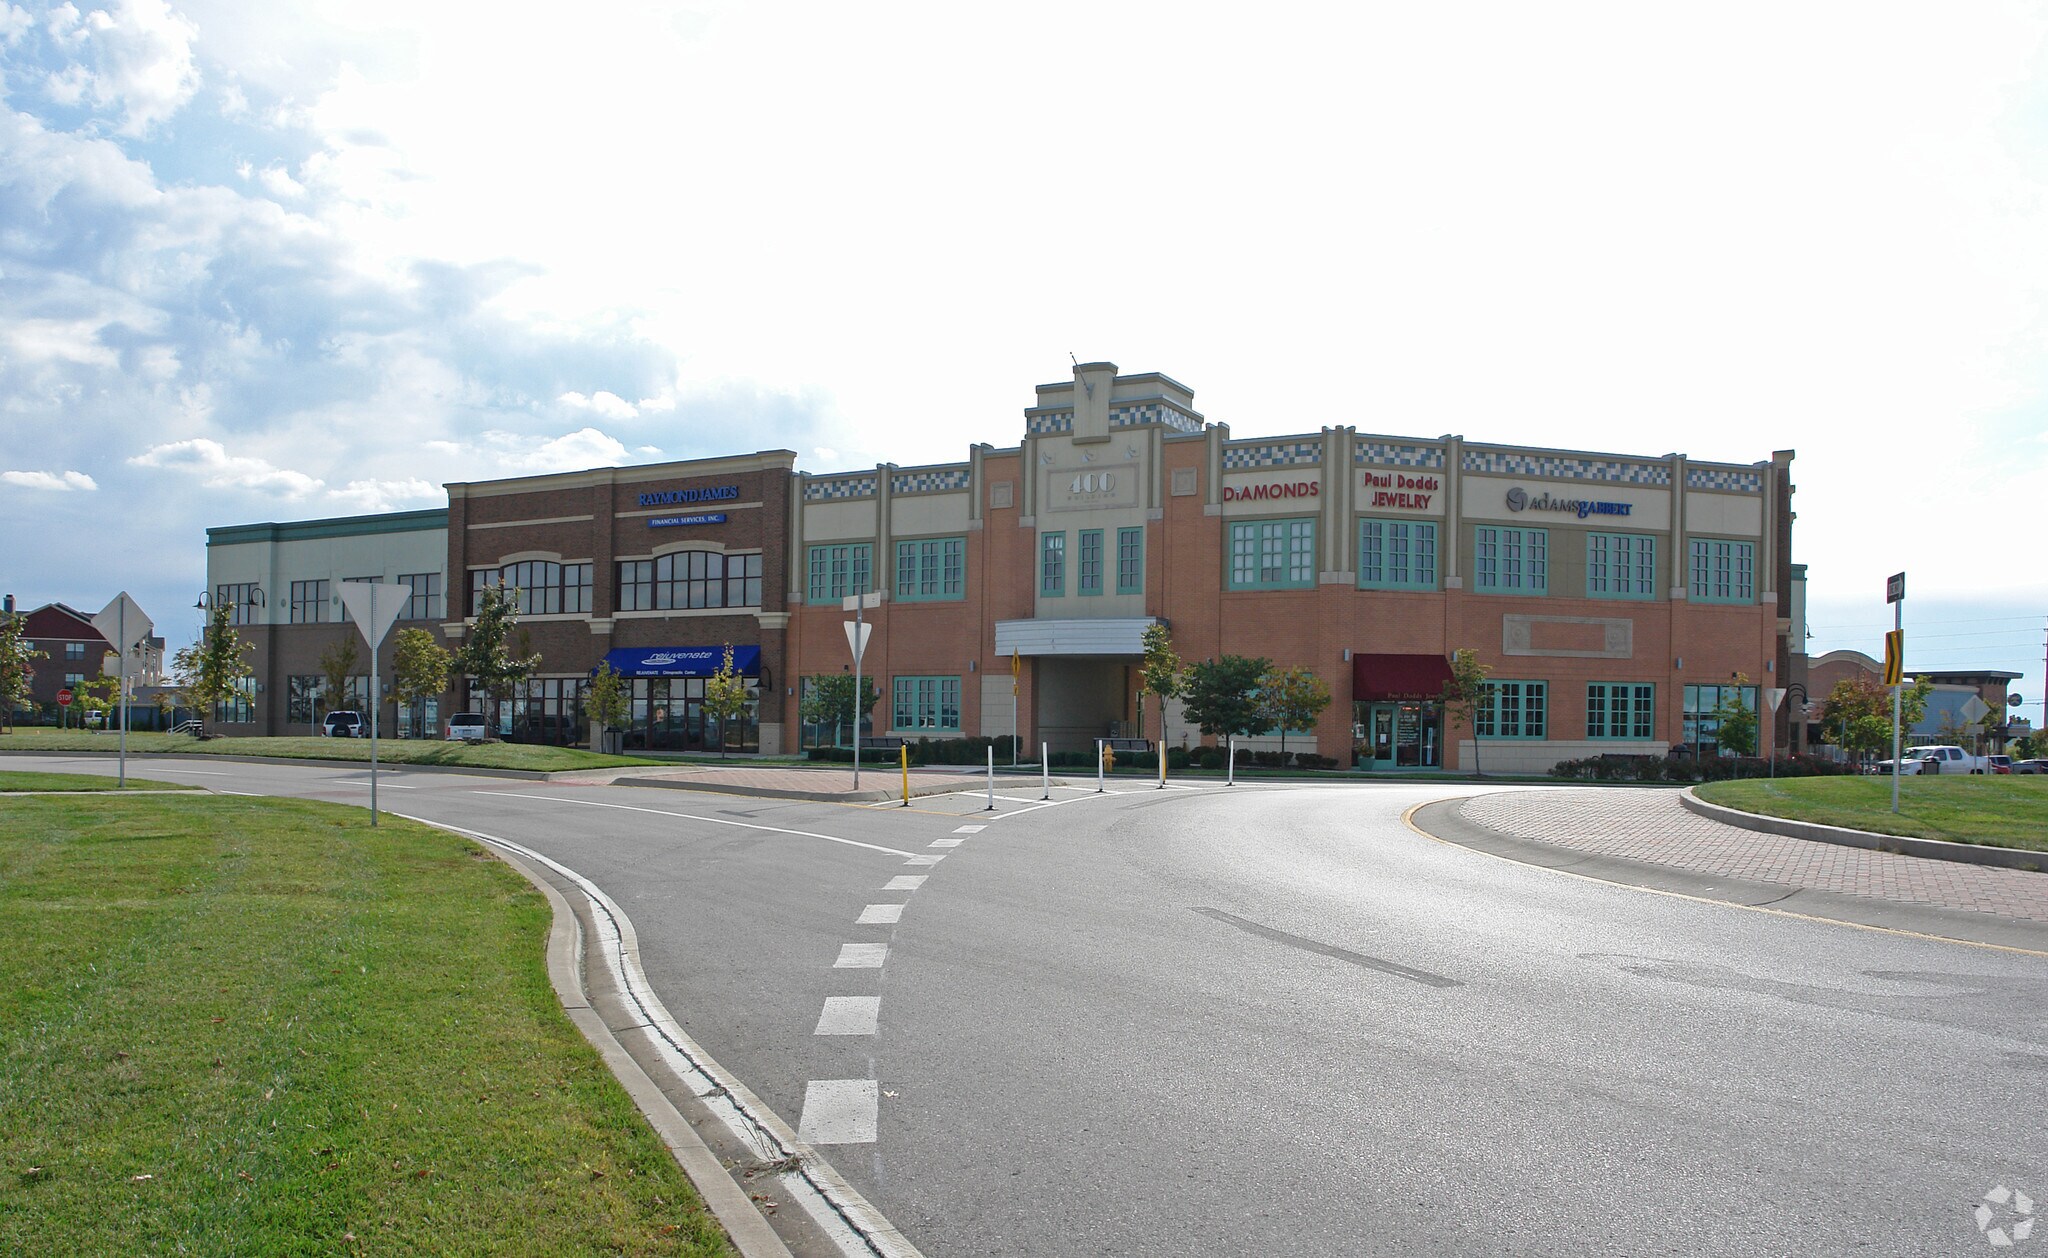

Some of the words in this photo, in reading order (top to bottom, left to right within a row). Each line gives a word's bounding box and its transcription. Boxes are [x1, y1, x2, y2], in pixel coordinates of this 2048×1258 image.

[1067, 472, 1115, 494] 400
[1365, 472, 1391, 487] Paul
[1397, 474, 1439, 491] Dodds
[639, 490, 697, 505] RAYMOND
[697, 486, 739, 500] JAMES
[1372, 491, 1432, 510] JEWELRY
[651, 517, 679, 525] FINANCIAL
